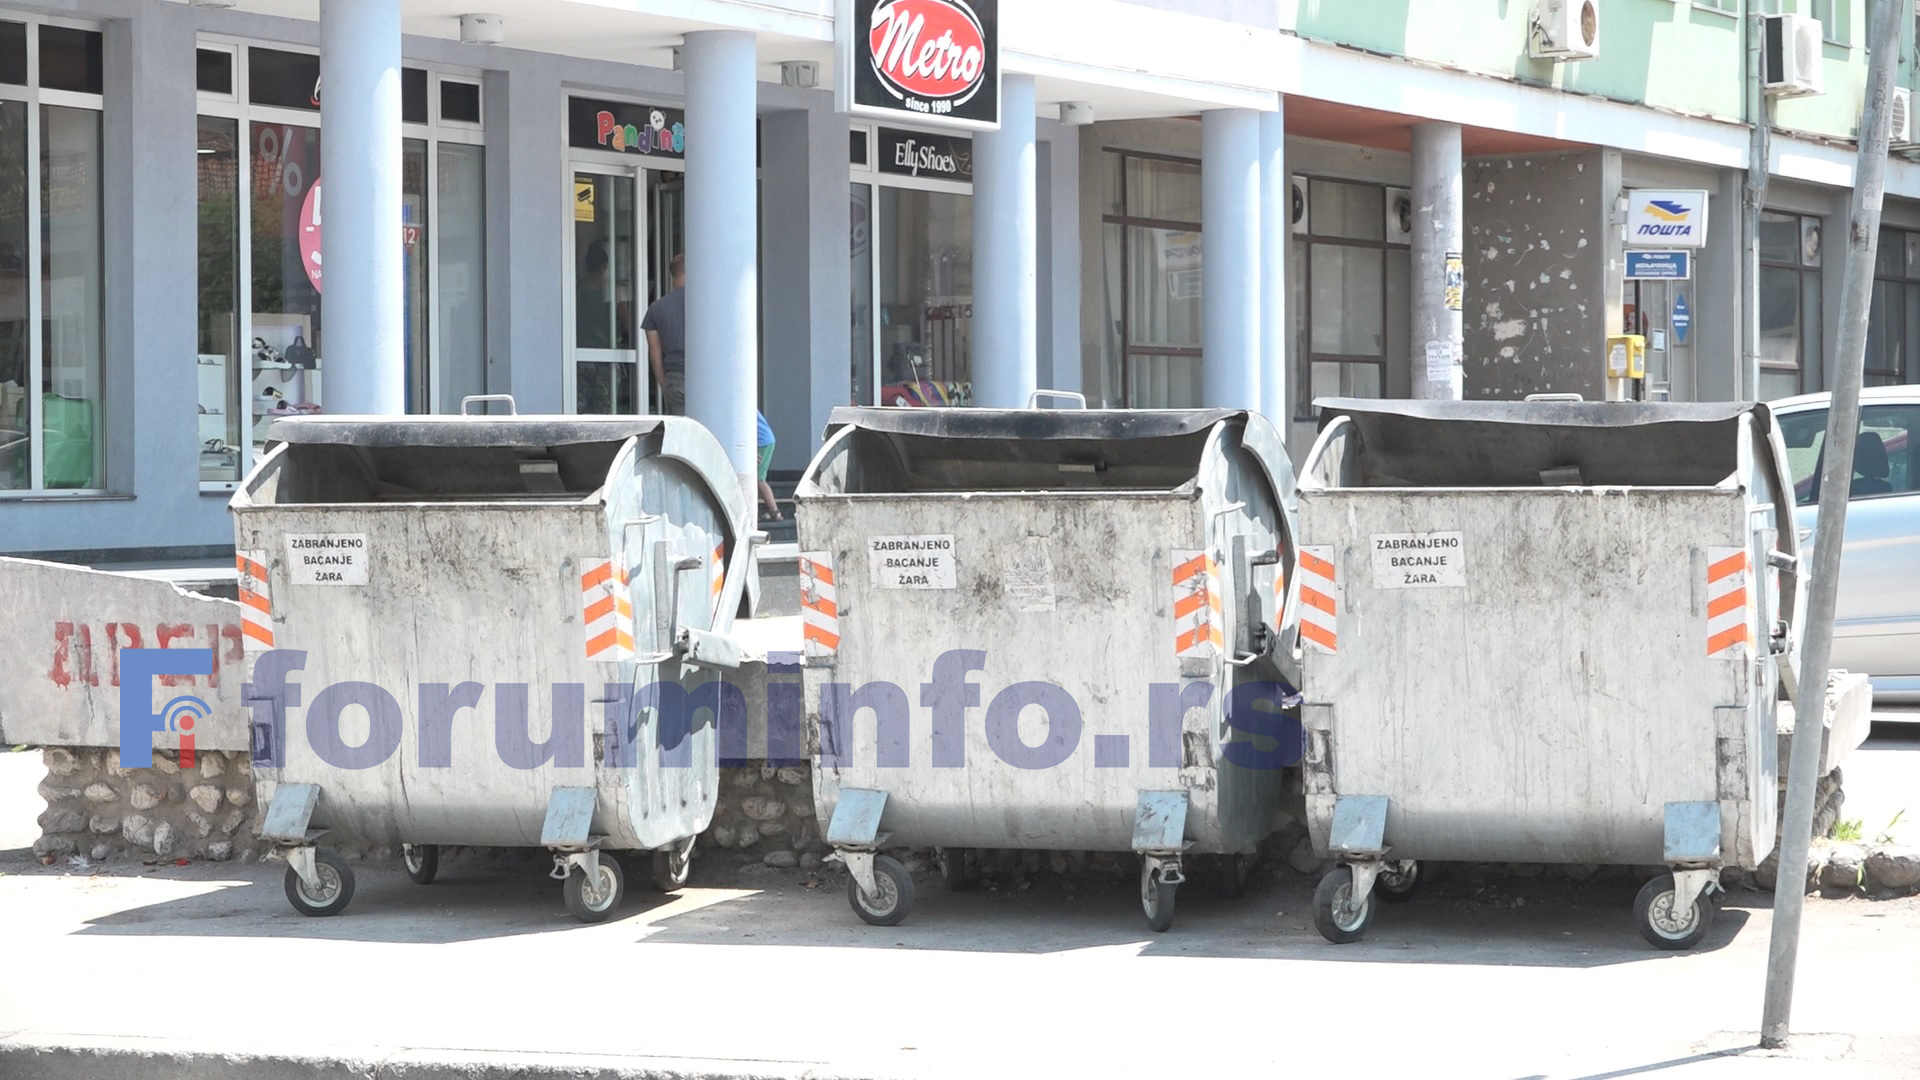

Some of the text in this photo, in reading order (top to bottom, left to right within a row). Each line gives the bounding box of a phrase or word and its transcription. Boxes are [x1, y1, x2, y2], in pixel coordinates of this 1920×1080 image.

[872, 4, 981, 83] Metro
[905, 97, 952, 113] since 1990
[597, 109, 685, 154] Pandino
[1637, 224, 1692, 236] ПОШТА
[291, 539, 363, 548] ZABRANJENO
[873, 540, 951, 551] ZABRANJENO
[1376, 538, 1459, 549] ZABRANJENO
[304, 555, 353, 565] BACANJE
[886, 557, 939, 567] BACANJE
[1391, 555, 1447, 566] BACANJE
